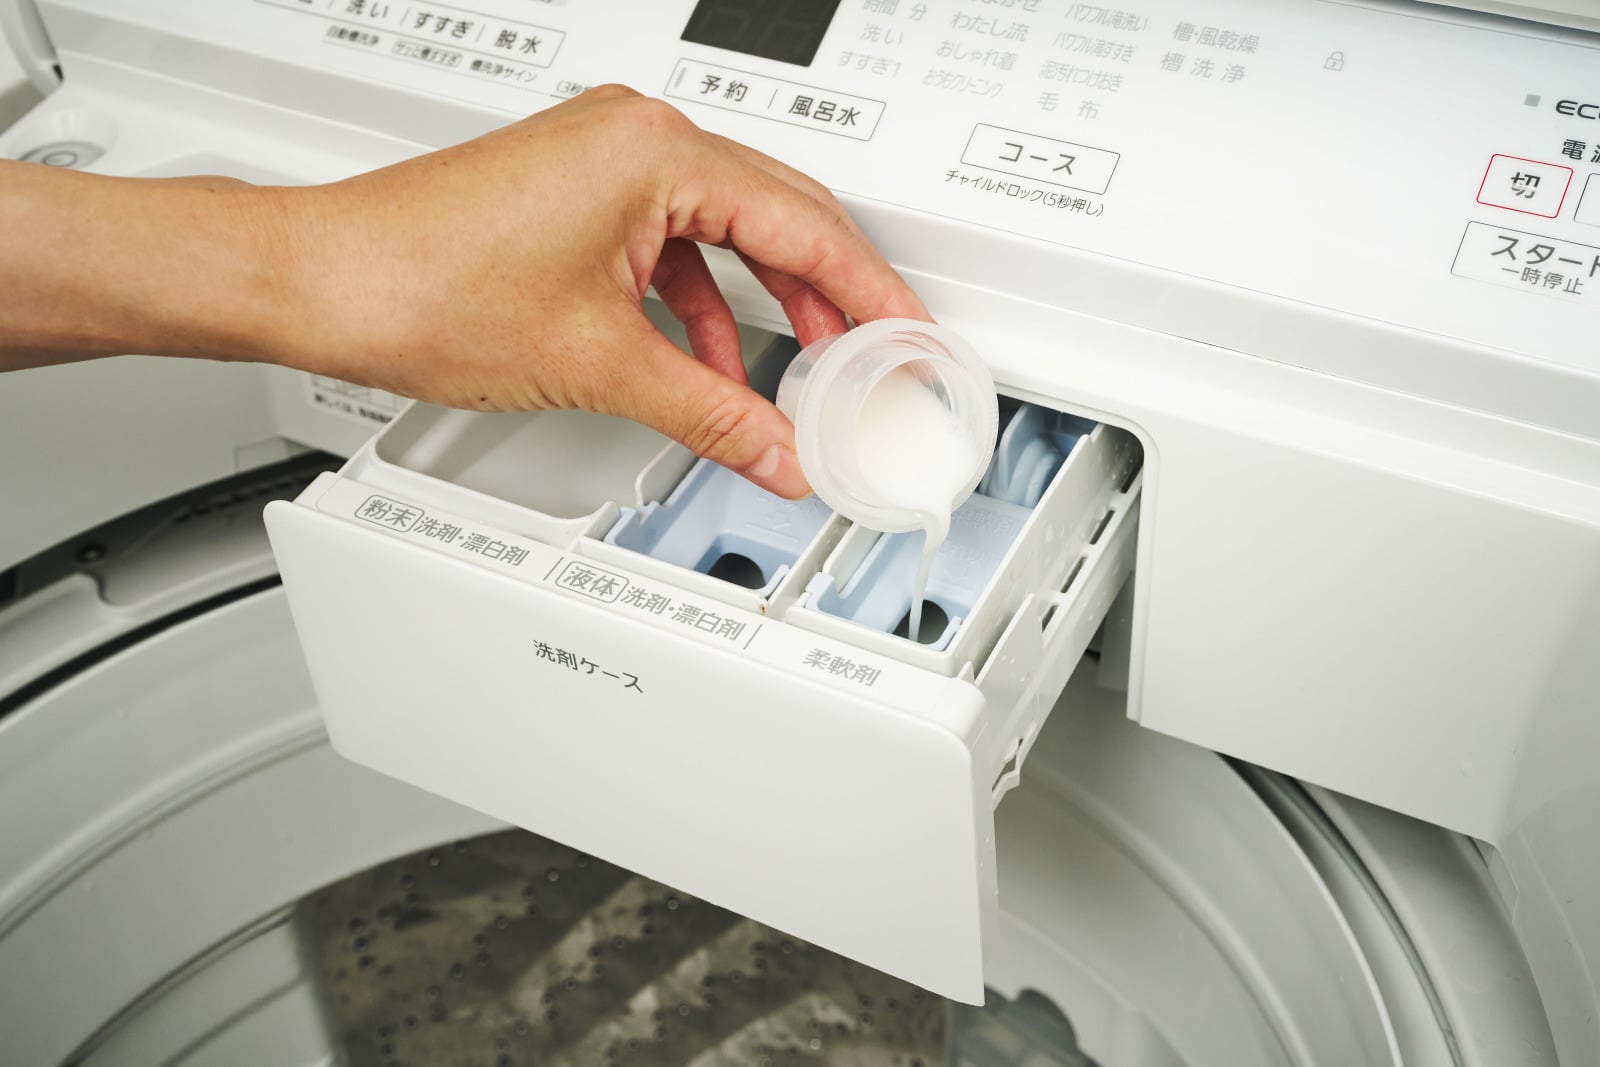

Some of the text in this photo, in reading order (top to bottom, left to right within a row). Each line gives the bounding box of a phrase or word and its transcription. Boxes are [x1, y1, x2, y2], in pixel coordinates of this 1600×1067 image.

[908, 1, 928, 22] 分
[948, 11, 1032, 43] わたし流
[413, 10, 475, 39] すすぎ
[493, 29, 543, 54] 脱水
[858, 23, 904, 46] 洗い
[935, 39, 1018, 71] おしゃれ着
[1159, 50, 1247, 84] 槽洗浄
[700, 75, 862, 127] 予約 風呂水
[1037, 91, 1103, 120] 毛布
[1556, 99, 1600, 120] EC
[998, 142, 1077, 175] コース
[944, 169, 1104, 217] チャイルドロック(5秒押し)
[1510, 171, 1541, 199] 切
[1491, 235, 1600, 278] スタート
[1501, 266, 1585, 295] 一時停止
[533, 639, 644, 694] 洗剤ケース
[802, 647, 881, 687] 柔軟剤
